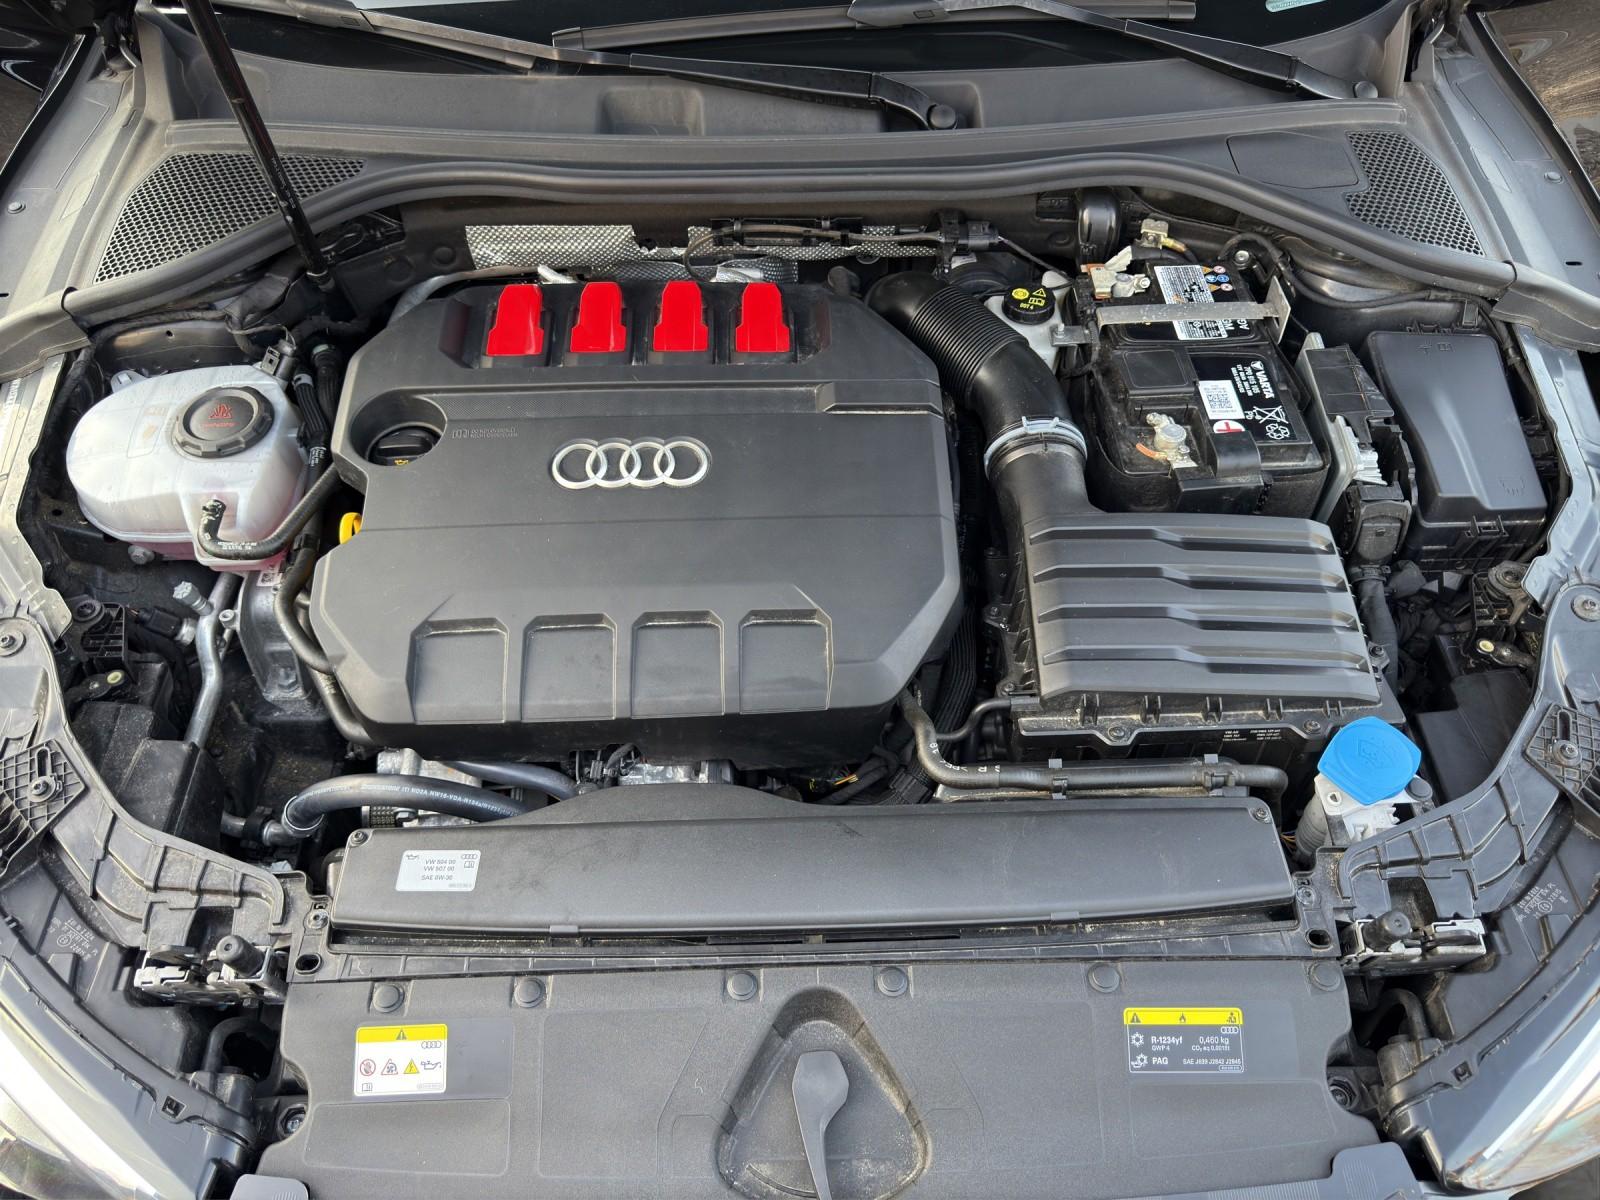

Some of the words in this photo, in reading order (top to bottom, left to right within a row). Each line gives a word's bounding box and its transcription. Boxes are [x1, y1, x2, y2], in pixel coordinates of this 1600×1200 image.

[1256, 370, 1274, 398] VARTA
[1244, 411, 1254, 420] Pb
[1151, 1036, 1182, 1045] R-1234yf
[1199, 1036, 1218, 1045] 0,460
[1220, 1036, 1229, 1045] kg
